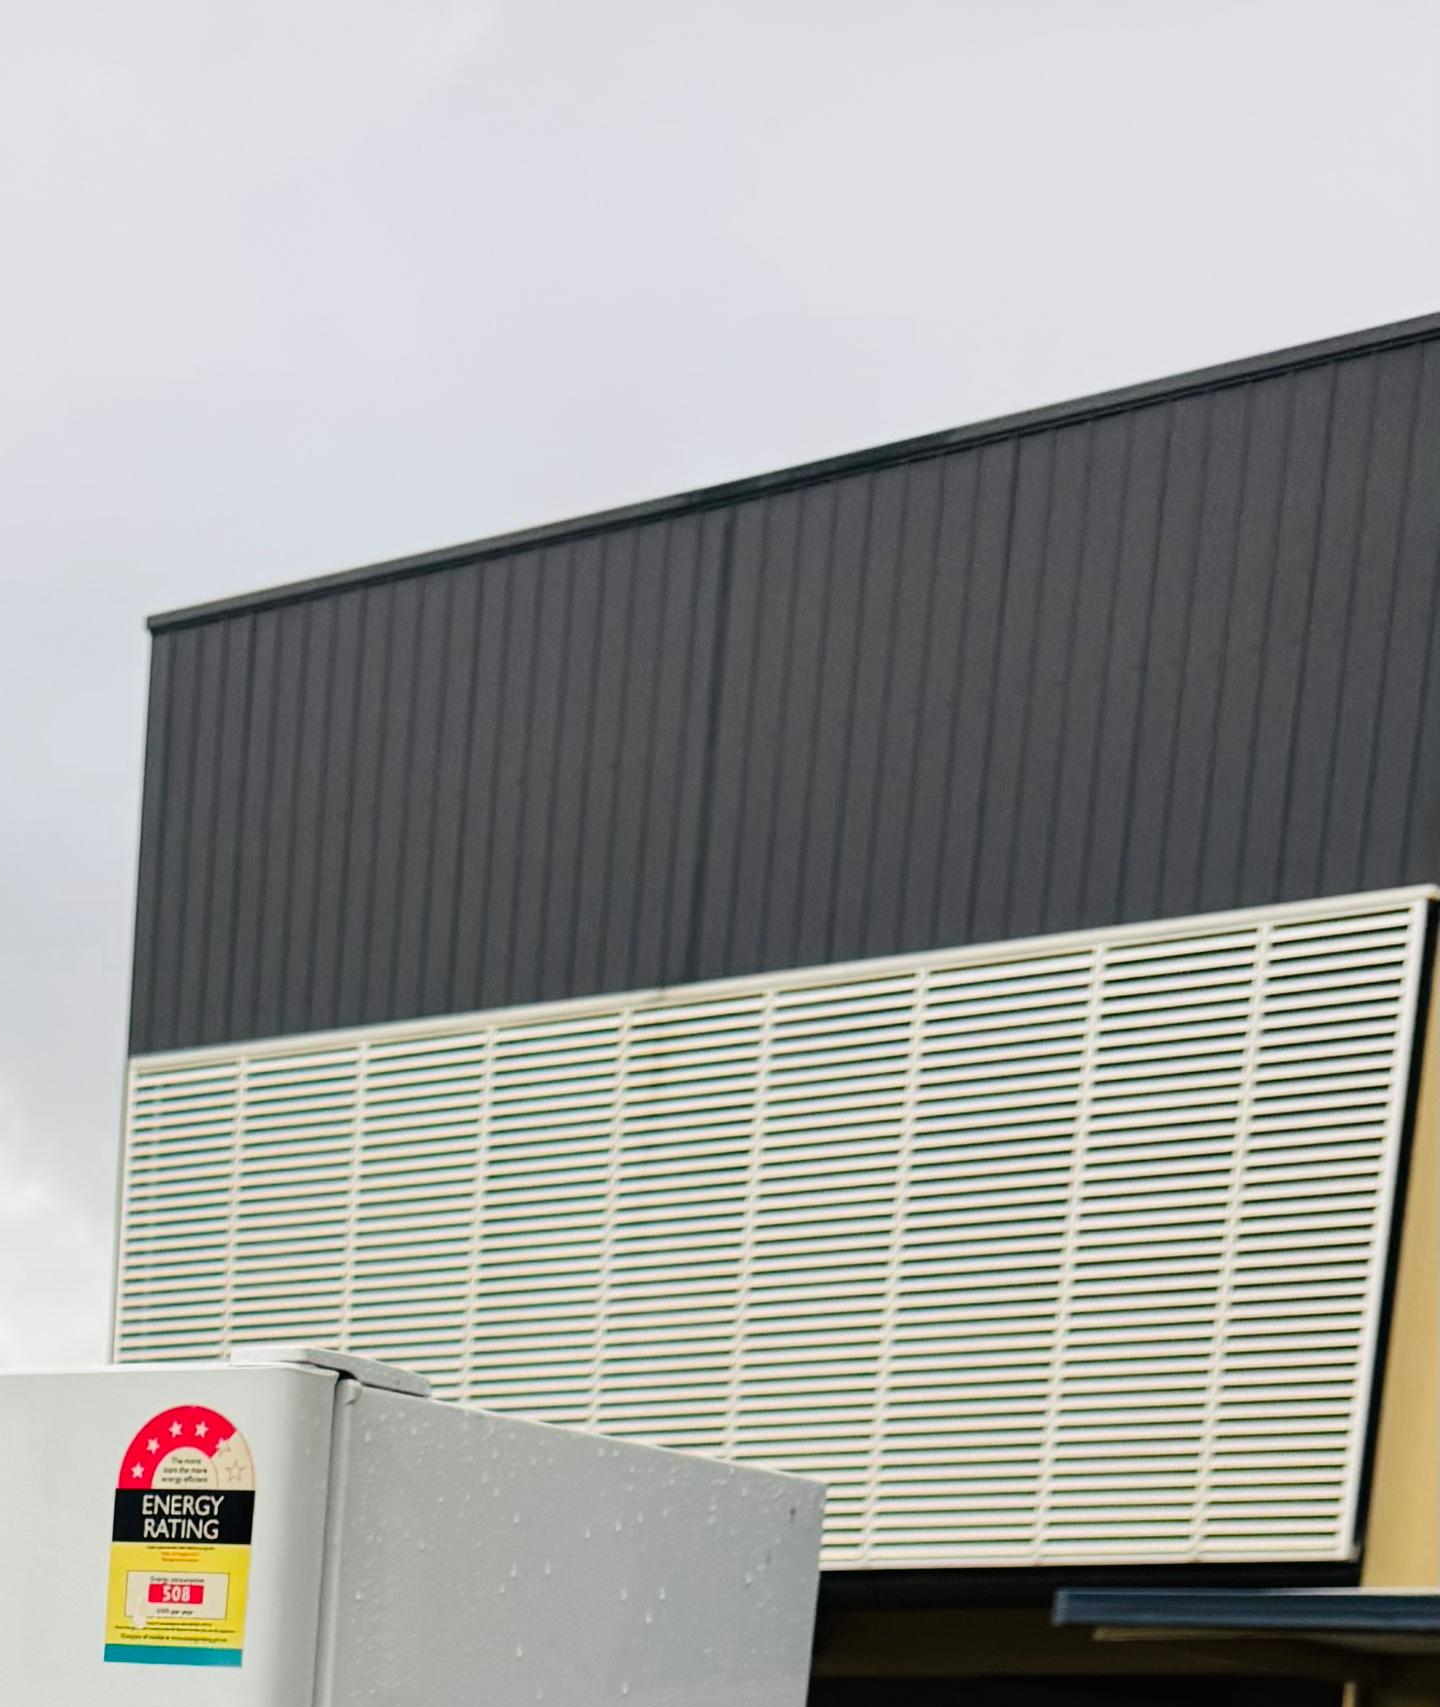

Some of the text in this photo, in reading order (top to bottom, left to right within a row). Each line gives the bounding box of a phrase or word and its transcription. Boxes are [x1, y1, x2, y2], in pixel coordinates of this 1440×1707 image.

[142, 1494, 225, 1516] ENERGY
[143, 1518, 220, 1540] RATING
[162, 1585, 191, 1602] 508
